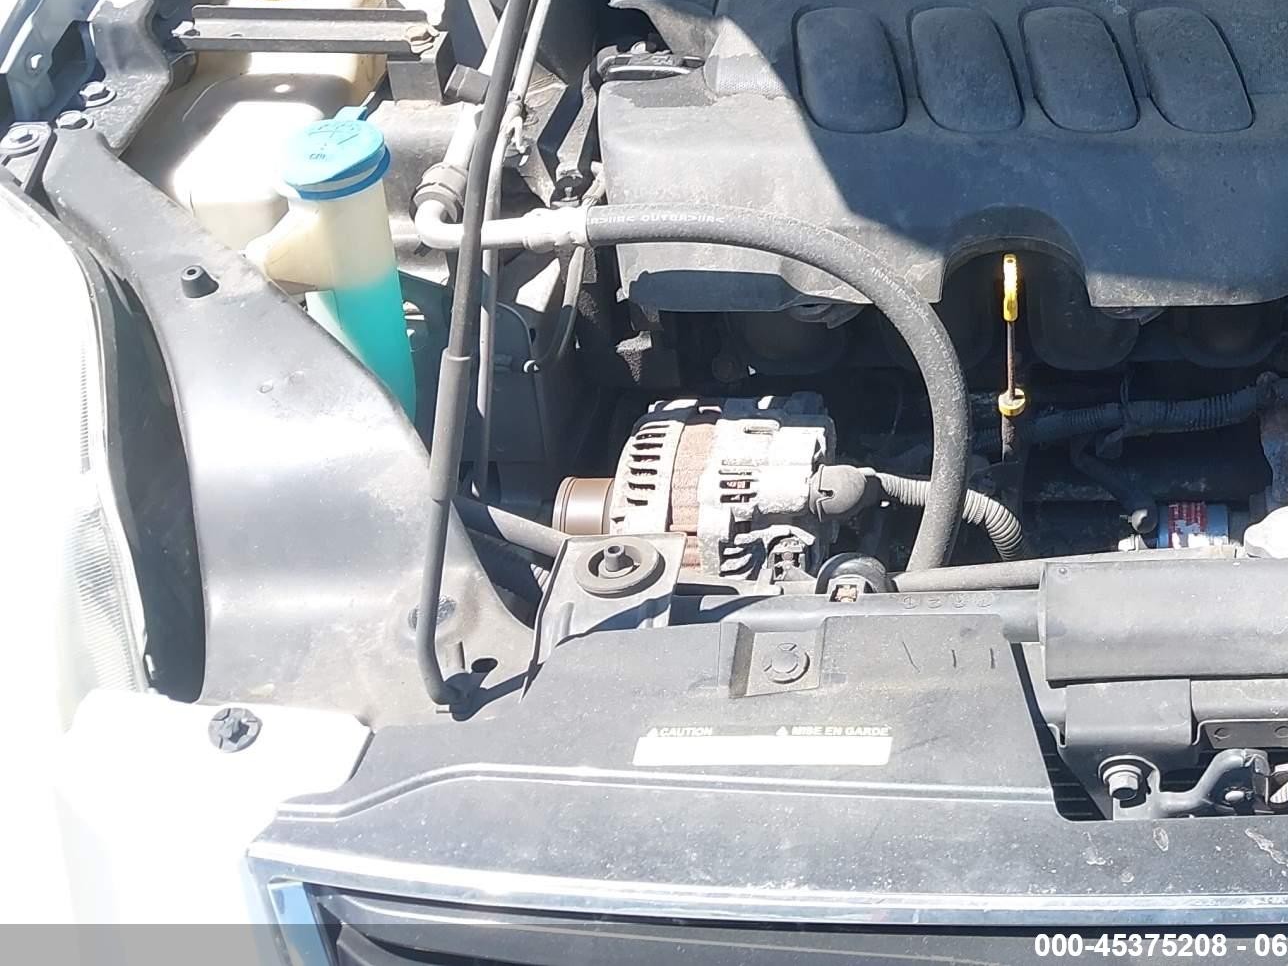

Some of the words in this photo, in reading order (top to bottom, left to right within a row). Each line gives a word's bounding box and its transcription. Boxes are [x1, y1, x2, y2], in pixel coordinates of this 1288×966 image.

[660, 726, 713, 736] CAUTION
[824, 726, 842, 736] EN
[845, 726, 889, 736] GARDE
